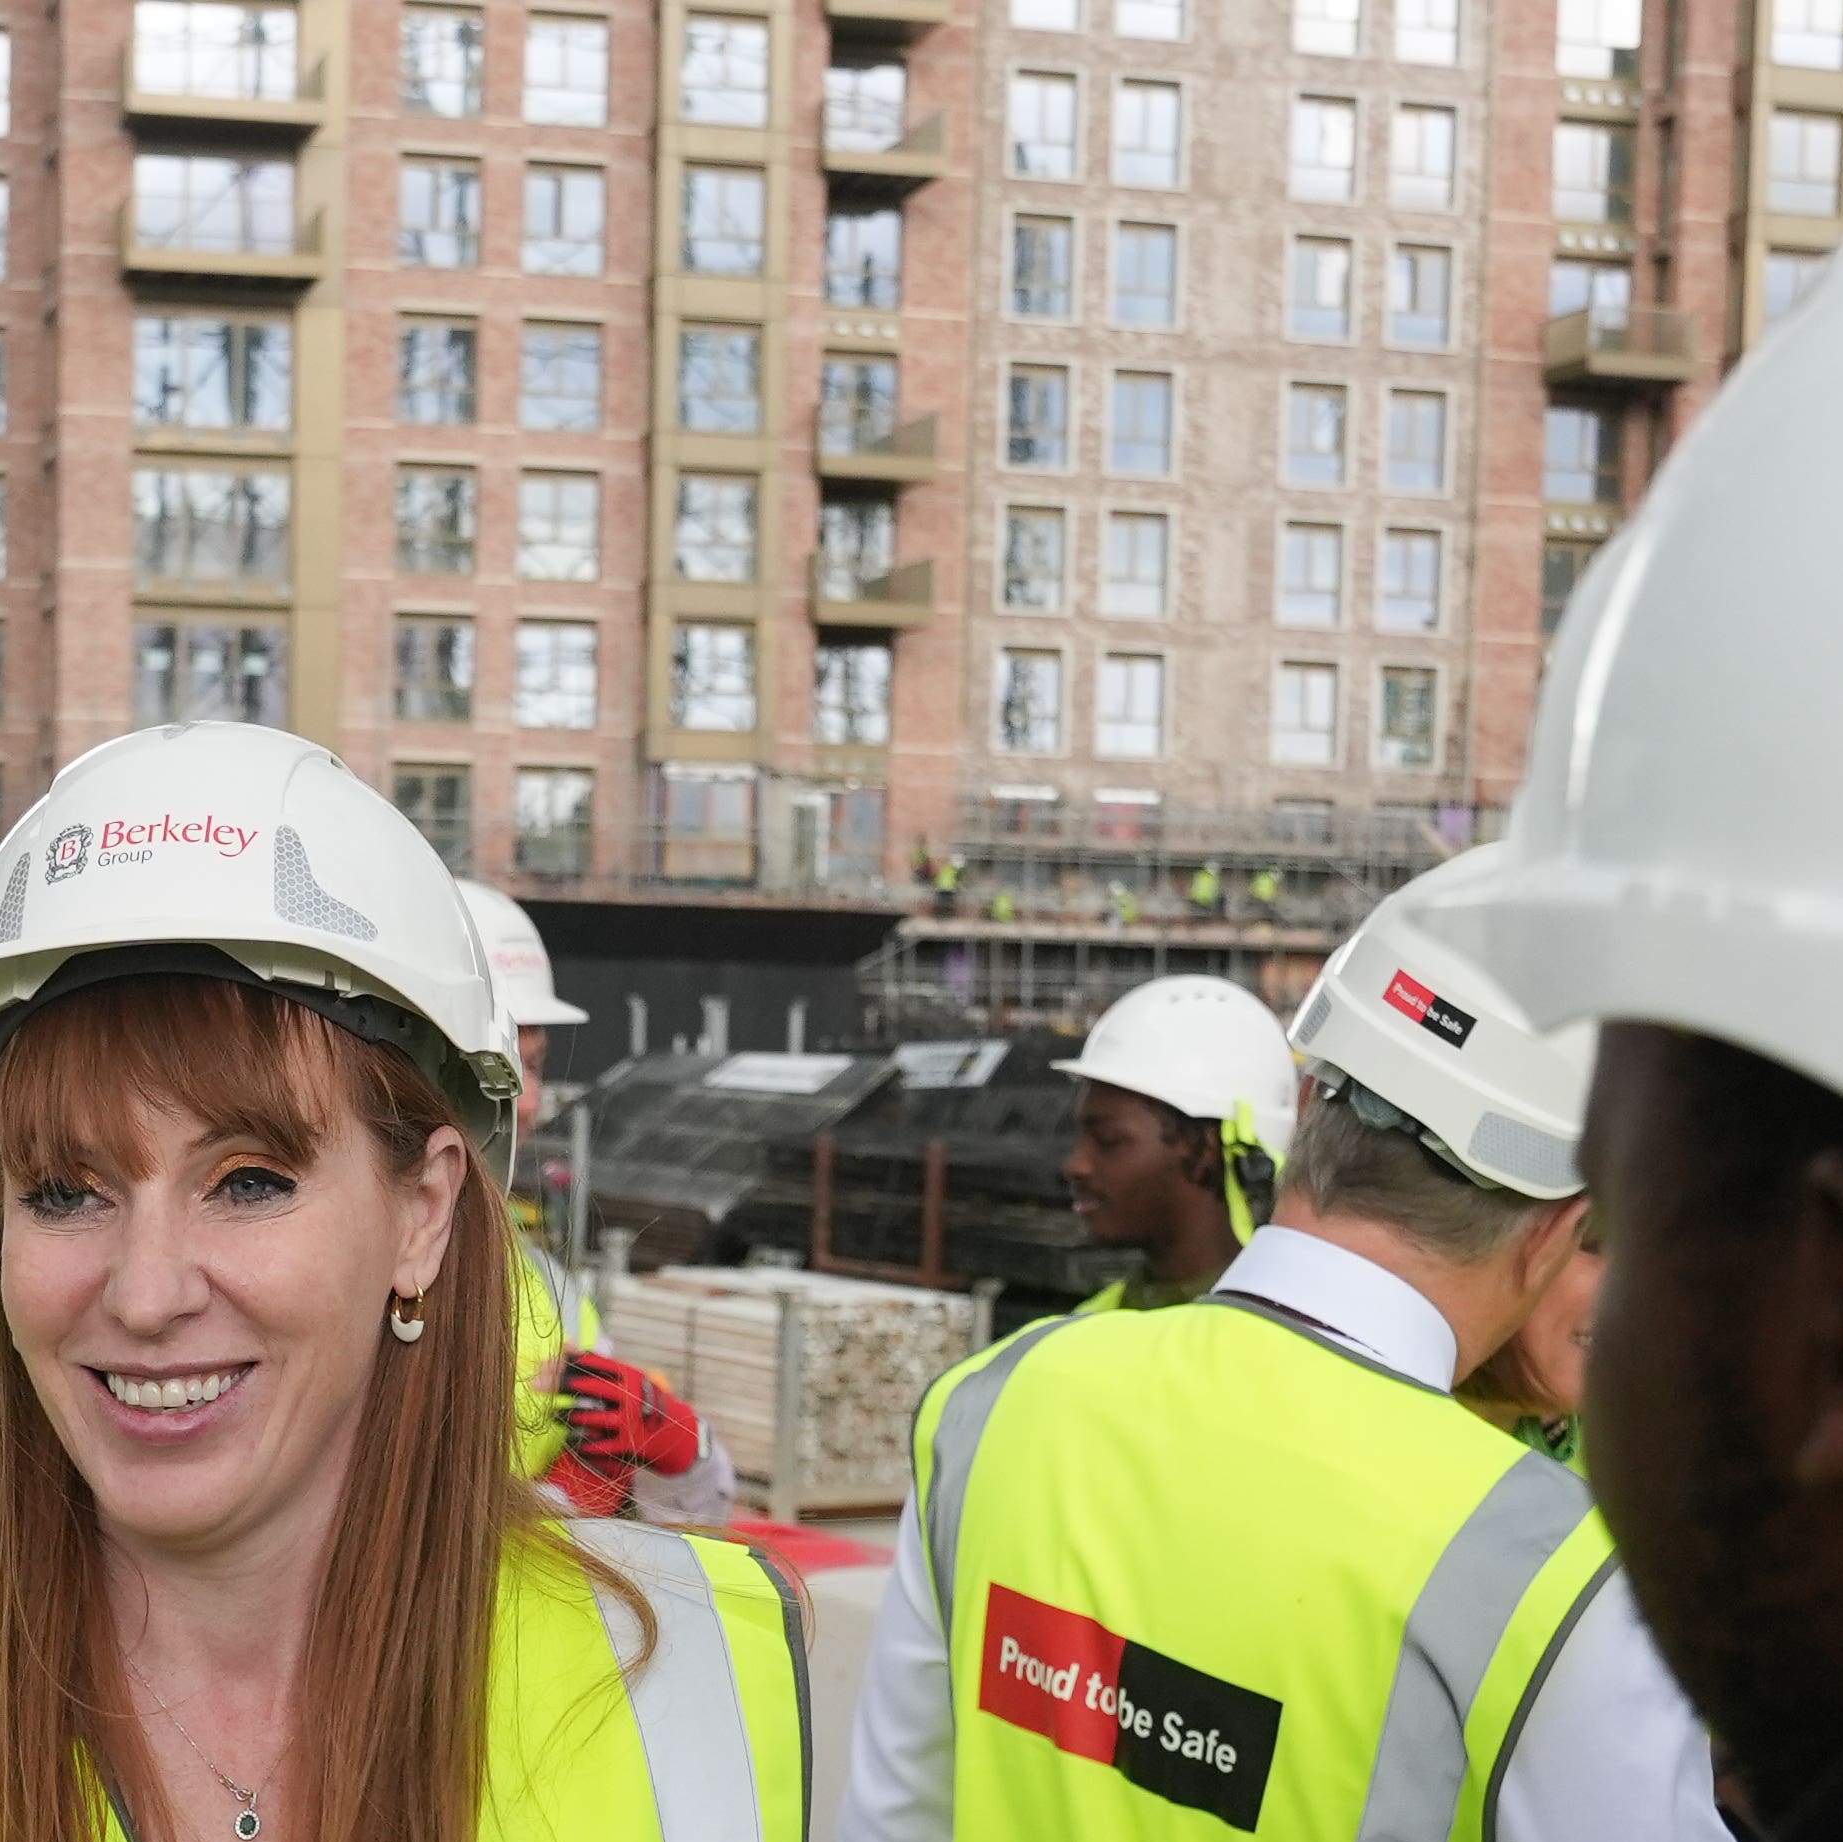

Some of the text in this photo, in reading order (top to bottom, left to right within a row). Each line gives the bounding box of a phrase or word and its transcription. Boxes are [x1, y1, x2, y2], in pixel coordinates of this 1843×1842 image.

[98, 849, 153, 867] Group
[100, 814, 259, 858] Berkeley
[1000, 1635, 1237, 1773] Proud to be Safe
